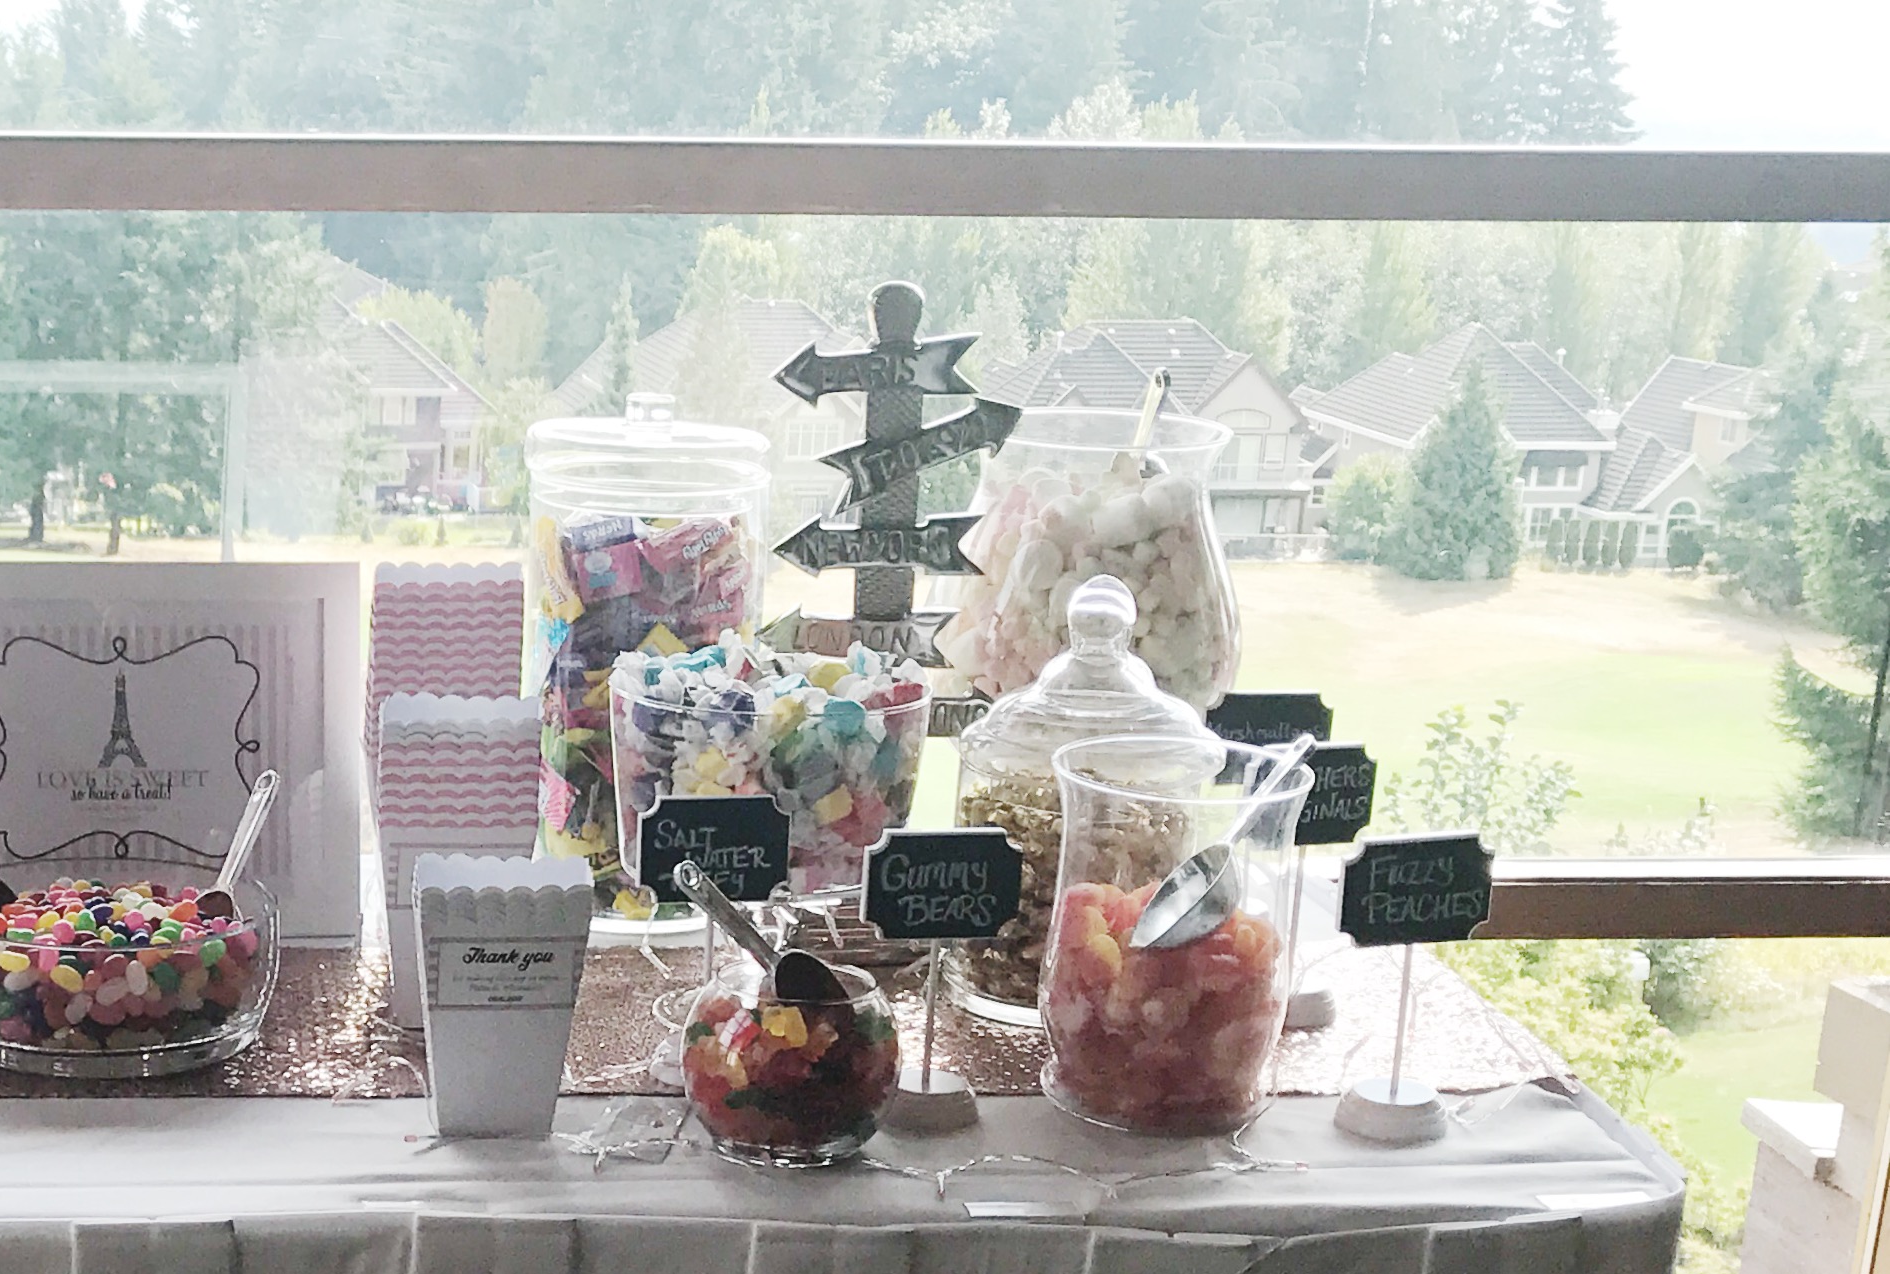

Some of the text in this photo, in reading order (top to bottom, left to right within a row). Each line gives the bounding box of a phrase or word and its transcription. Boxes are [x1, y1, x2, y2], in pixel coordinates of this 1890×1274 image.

[821, 355, 918, 389] PARIS
[37, 769, 209, 789] LOVE IS SWEET
[654, 819, 717, 851] SALT
[898, 893, 997, 927] BEARS
[1361, 889, 1484, 924] PEACHES
[462, 947, 554, 971] Thank you
